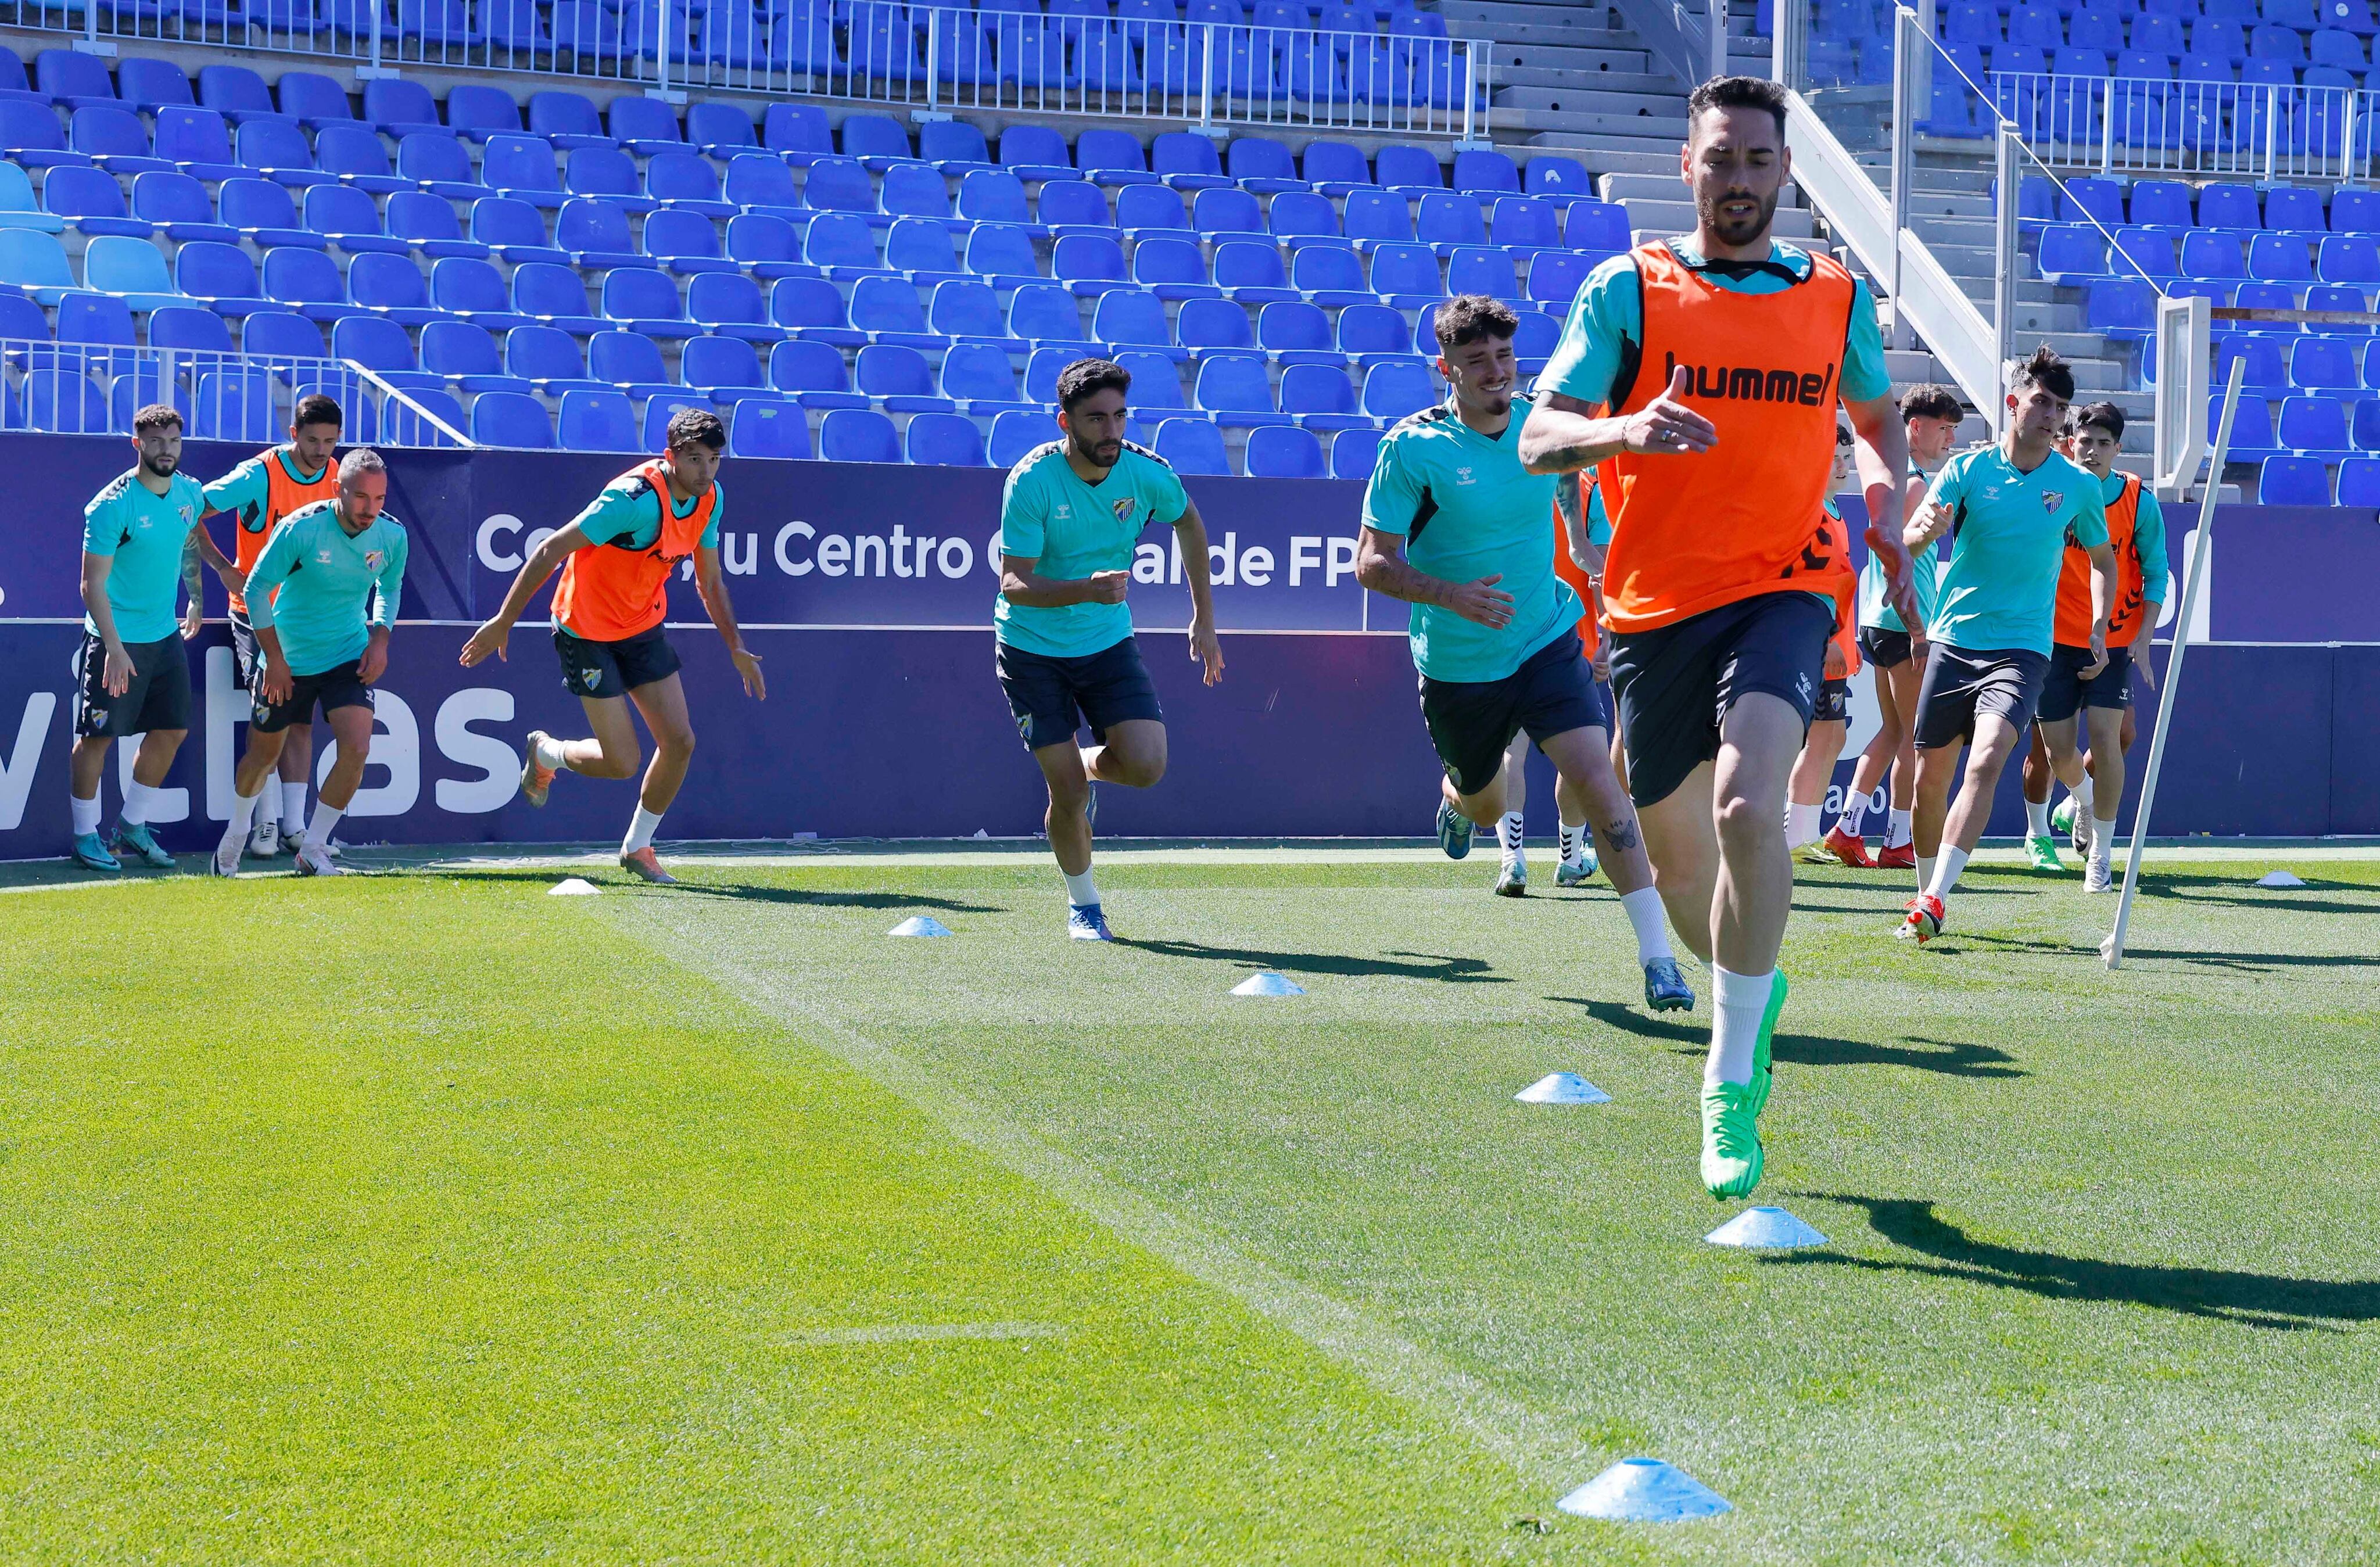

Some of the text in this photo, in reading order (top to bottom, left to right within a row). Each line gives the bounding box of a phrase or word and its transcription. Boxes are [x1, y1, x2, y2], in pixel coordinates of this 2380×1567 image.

[1665, 350, 1834, 407] hummel
[716, 532, 758, 575] u
[774, 521, 973, 579] Centro
[1209, 532, 1275, 586] de
[1289, 536, 1359, 587] FP
